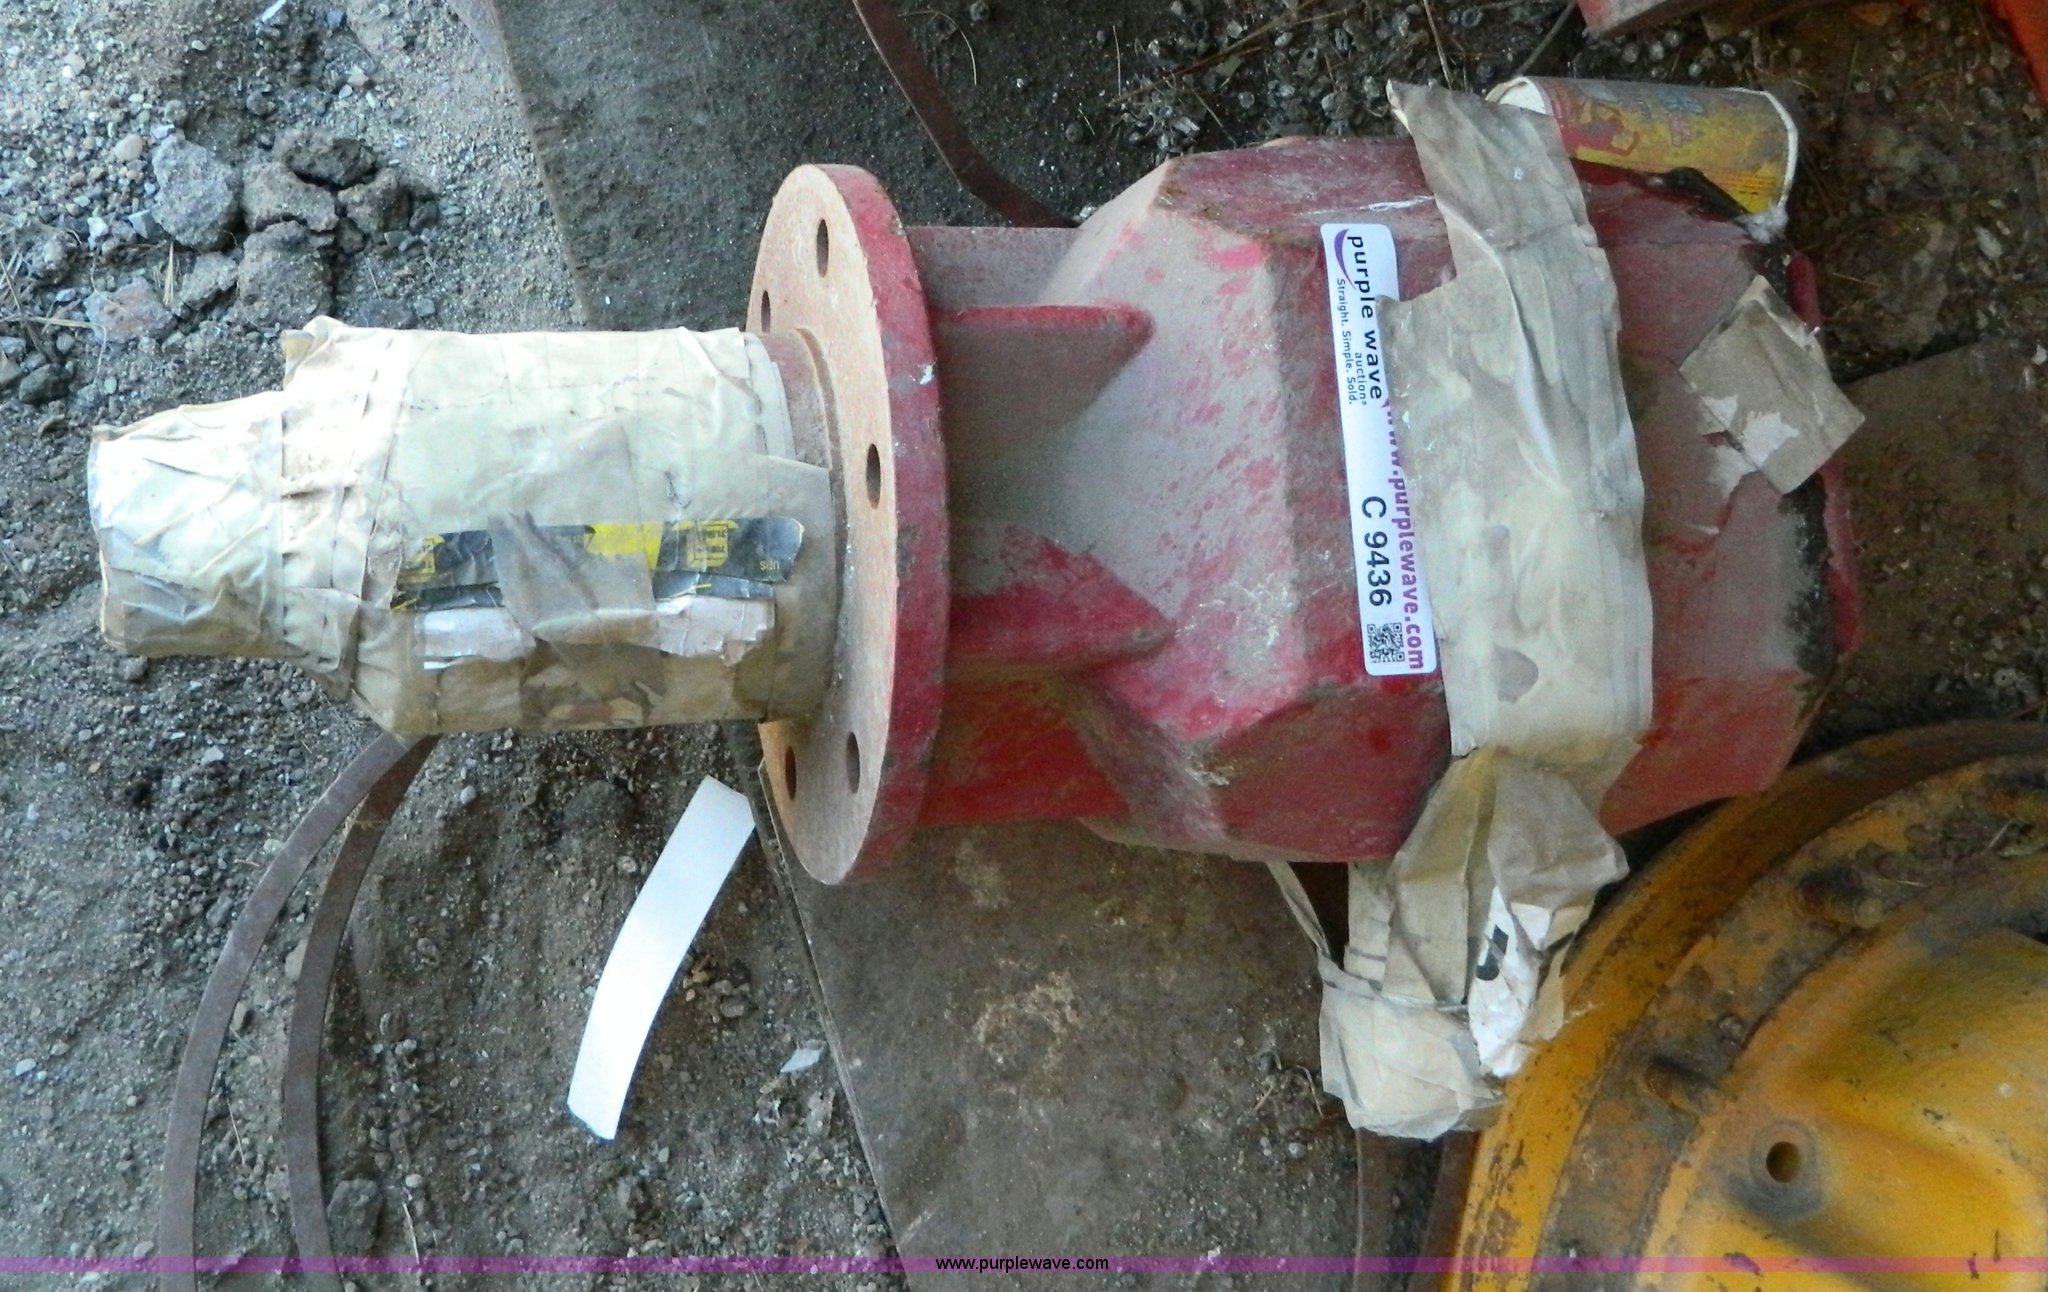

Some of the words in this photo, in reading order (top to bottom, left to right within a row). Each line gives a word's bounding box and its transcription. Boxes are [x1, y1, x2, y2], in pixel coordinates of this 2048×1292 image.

[1336, 278, 1350, 327] Straight.
[1347, 236, 1376, 319] purple
[1364, 329, 1383, 400] wave
[1341, 330, 1355, 374] Simple.
[1346, 376, 1358, 405] Sold.
[1361, 496, 1387, 519] C
[1364, 531, 1393, 607] 9436
